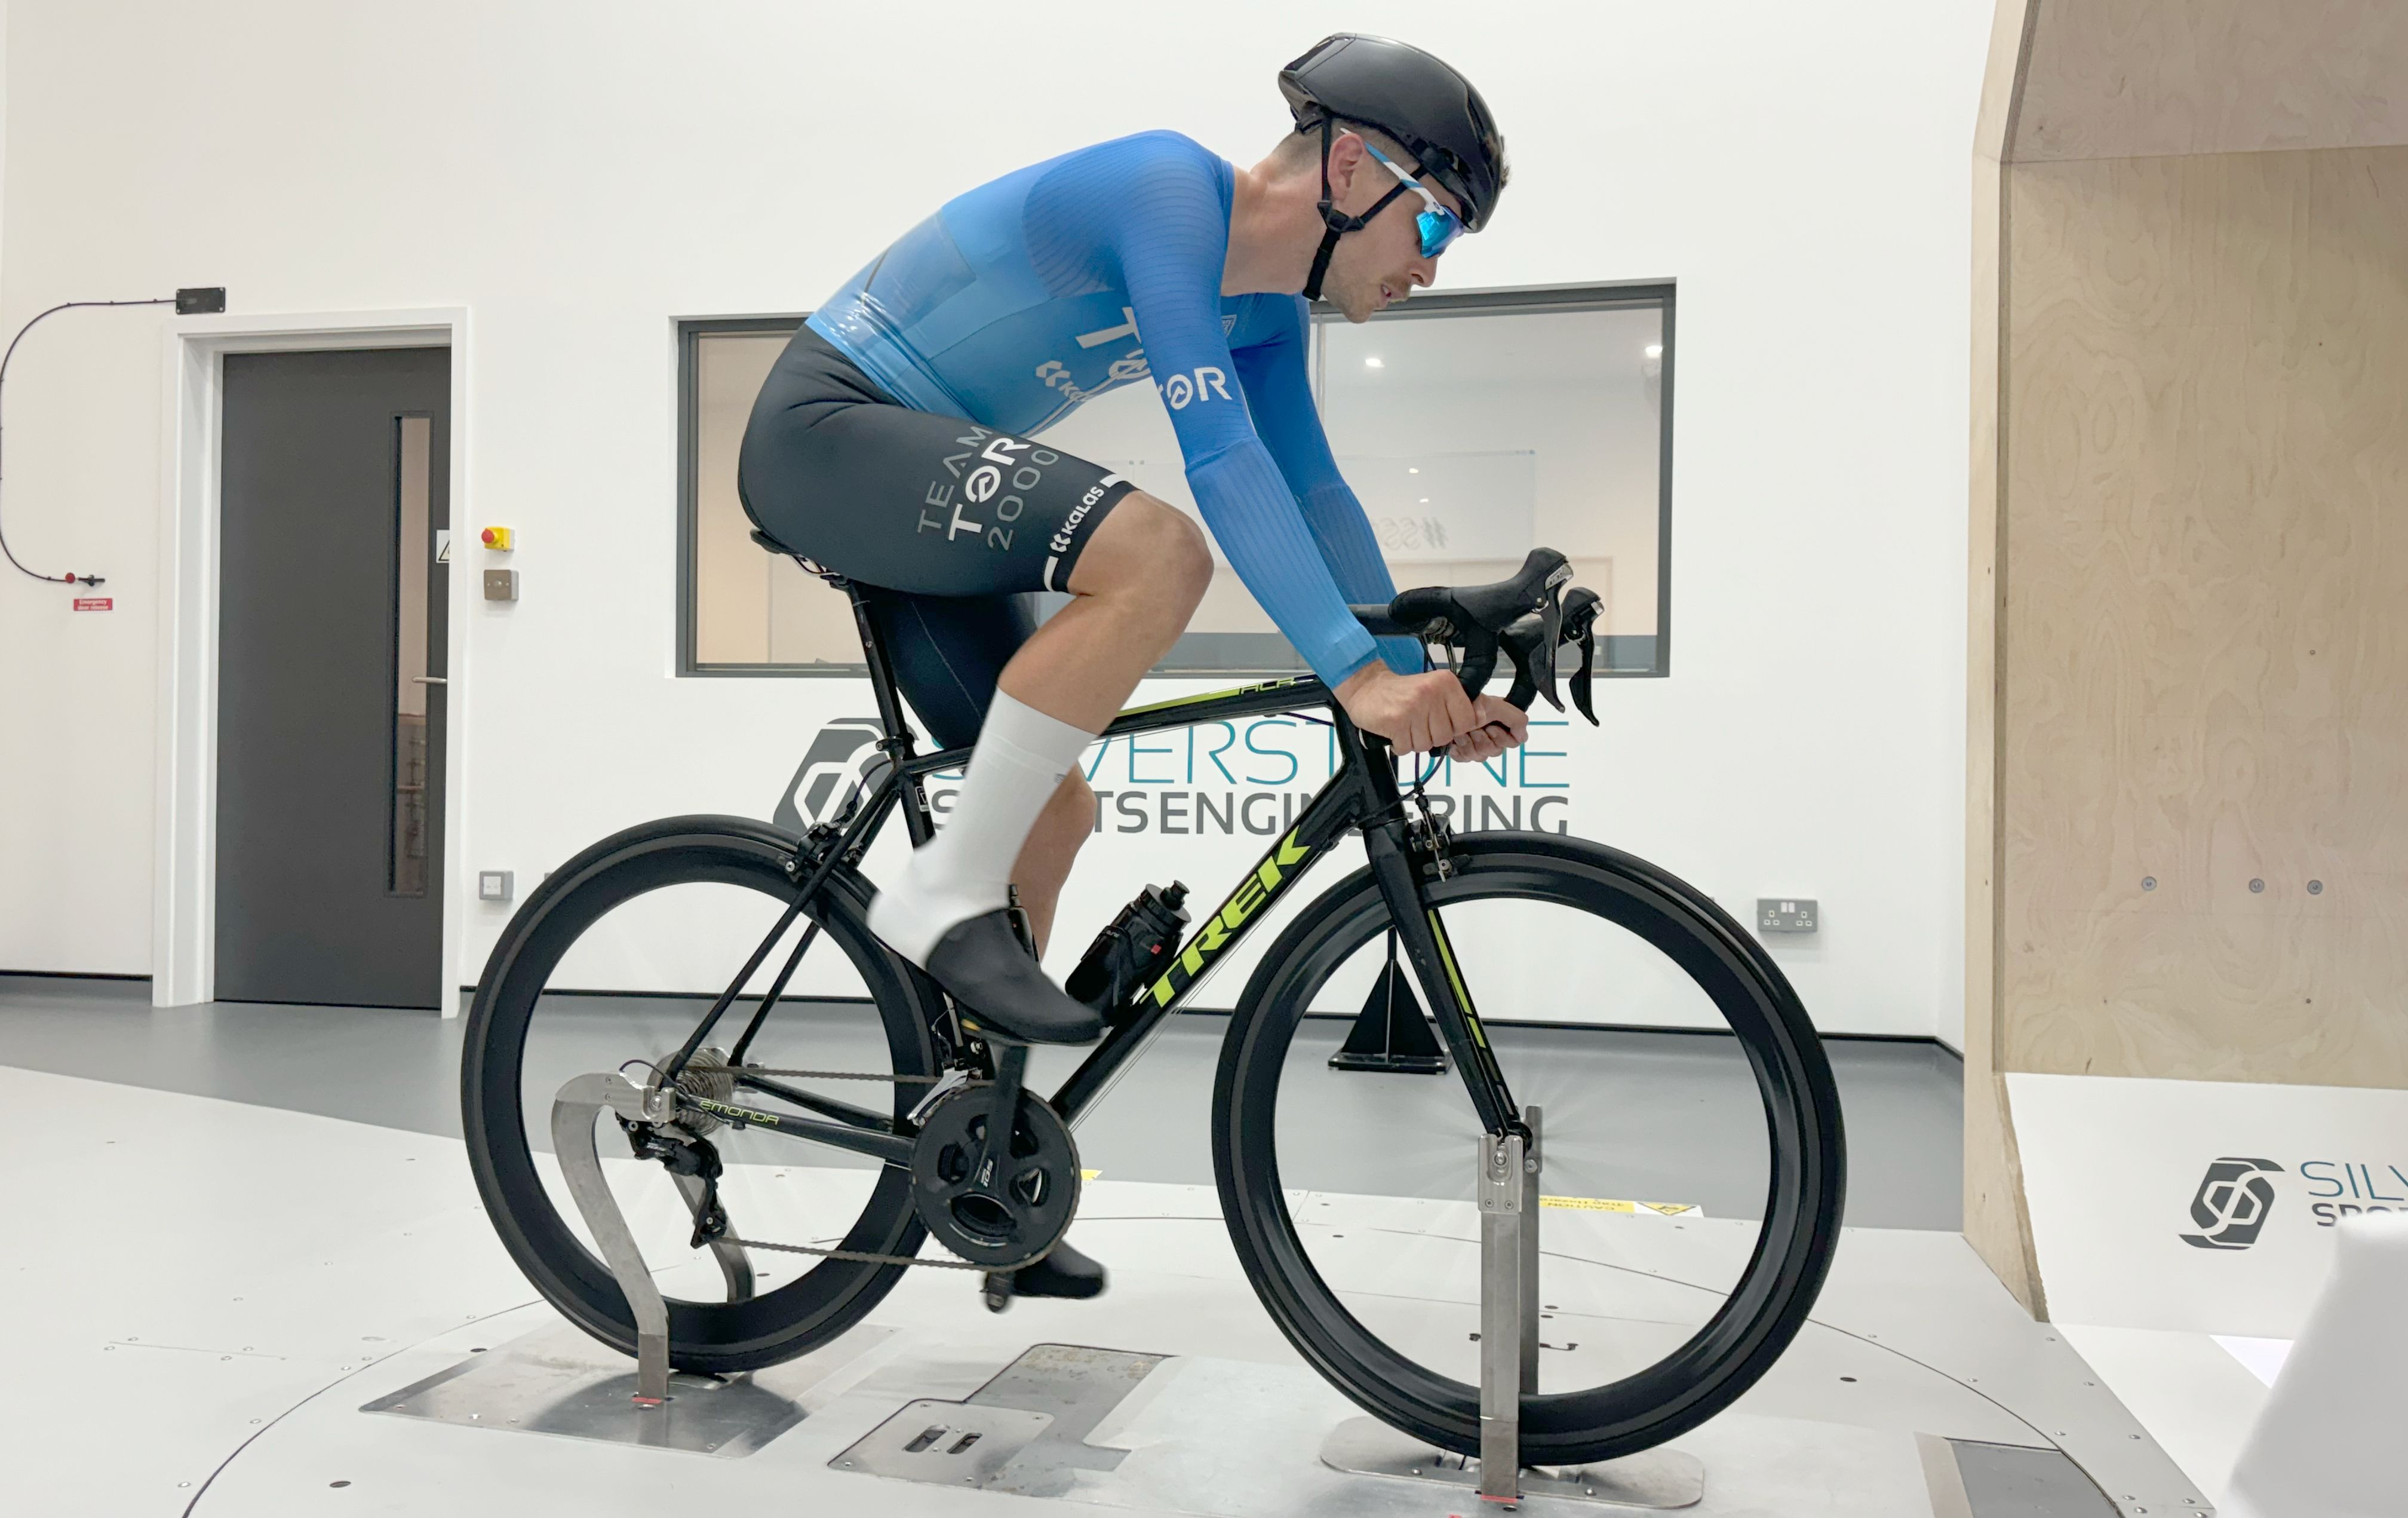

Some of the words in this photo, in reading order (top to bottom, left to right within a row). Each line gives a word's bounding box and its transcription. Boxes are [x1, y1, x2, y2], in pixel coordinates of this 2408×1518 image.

[1158, 366, 1233, 410] OR
[917, 425, 993, 533] TEAM
[987, 449, 1059, 551] 2000
[1139, 824, 1312, 1008] TREK
